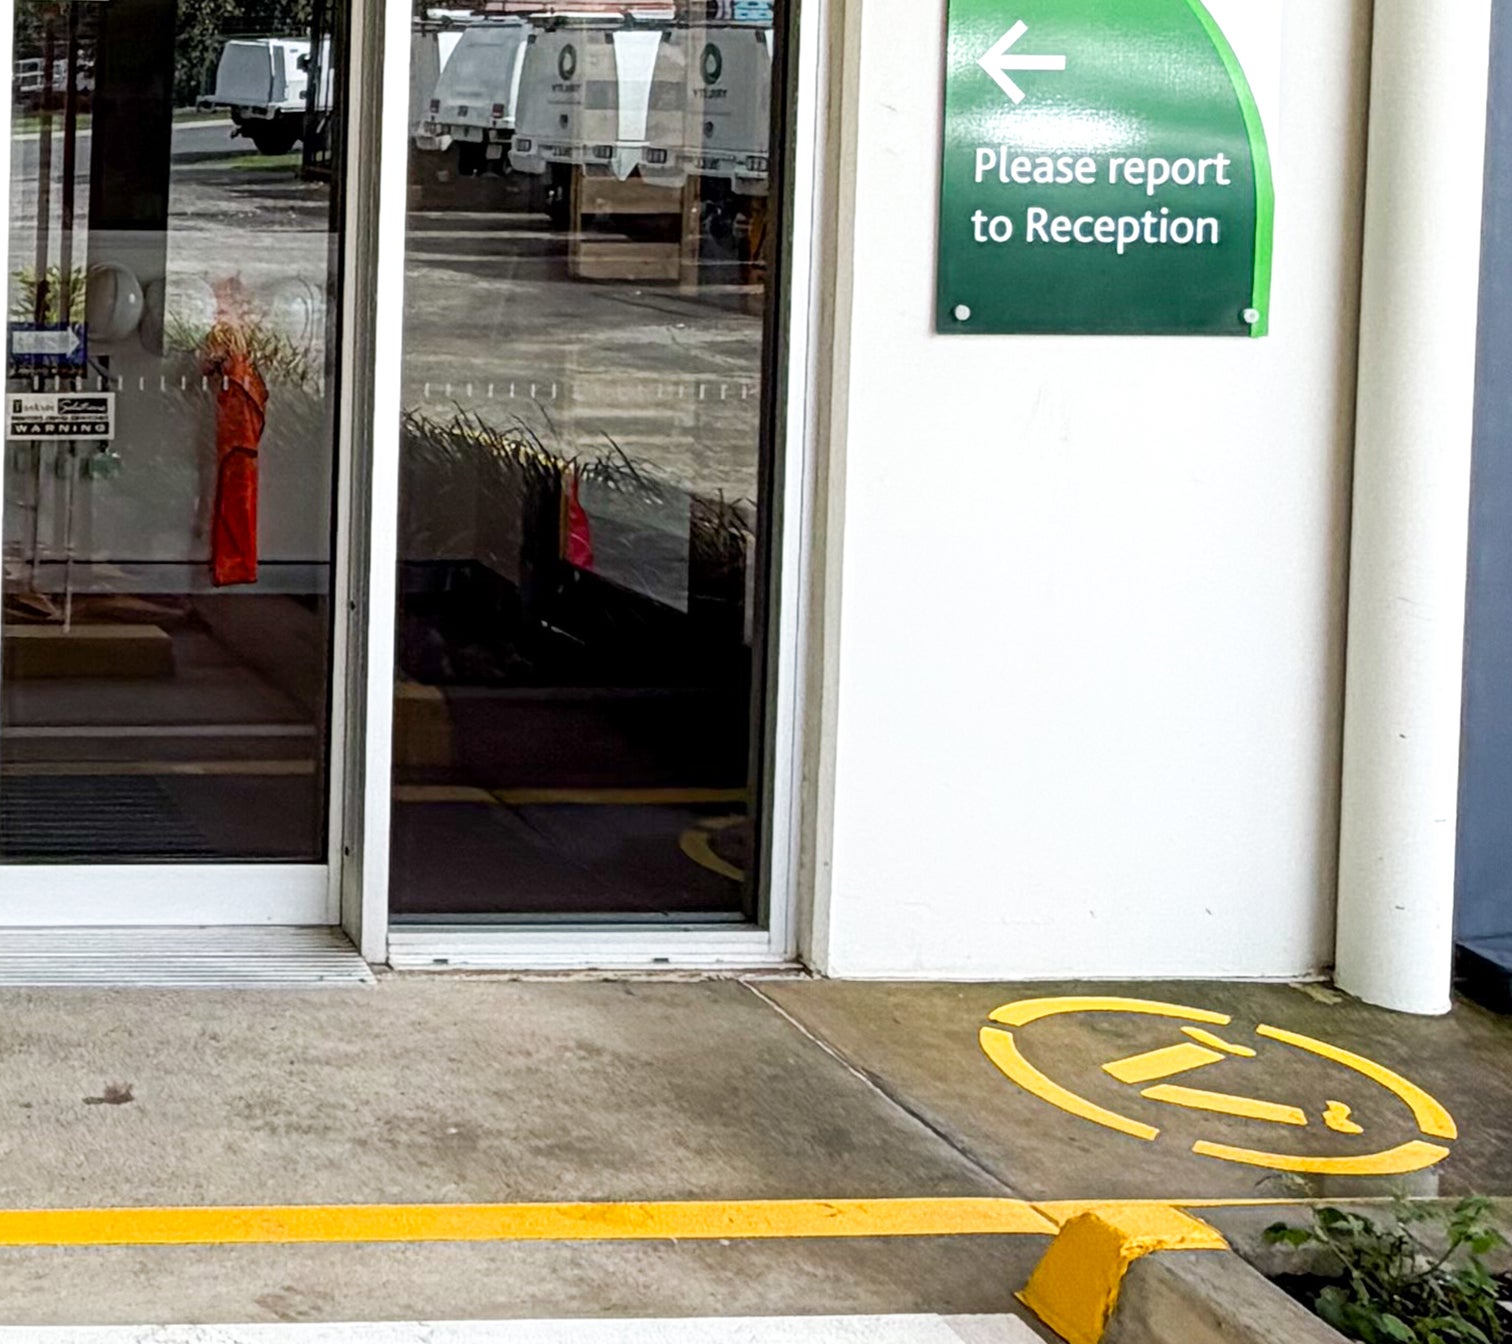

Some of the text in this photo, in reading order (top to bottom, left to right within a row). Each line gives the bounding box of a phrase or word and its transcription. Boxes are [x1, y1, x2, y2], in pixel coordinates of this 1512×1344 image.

[974, 146, 1232, 196] Please report
[971, 206, 1219, 255] to Reception
[15, 423, 106, 433] WARNING
